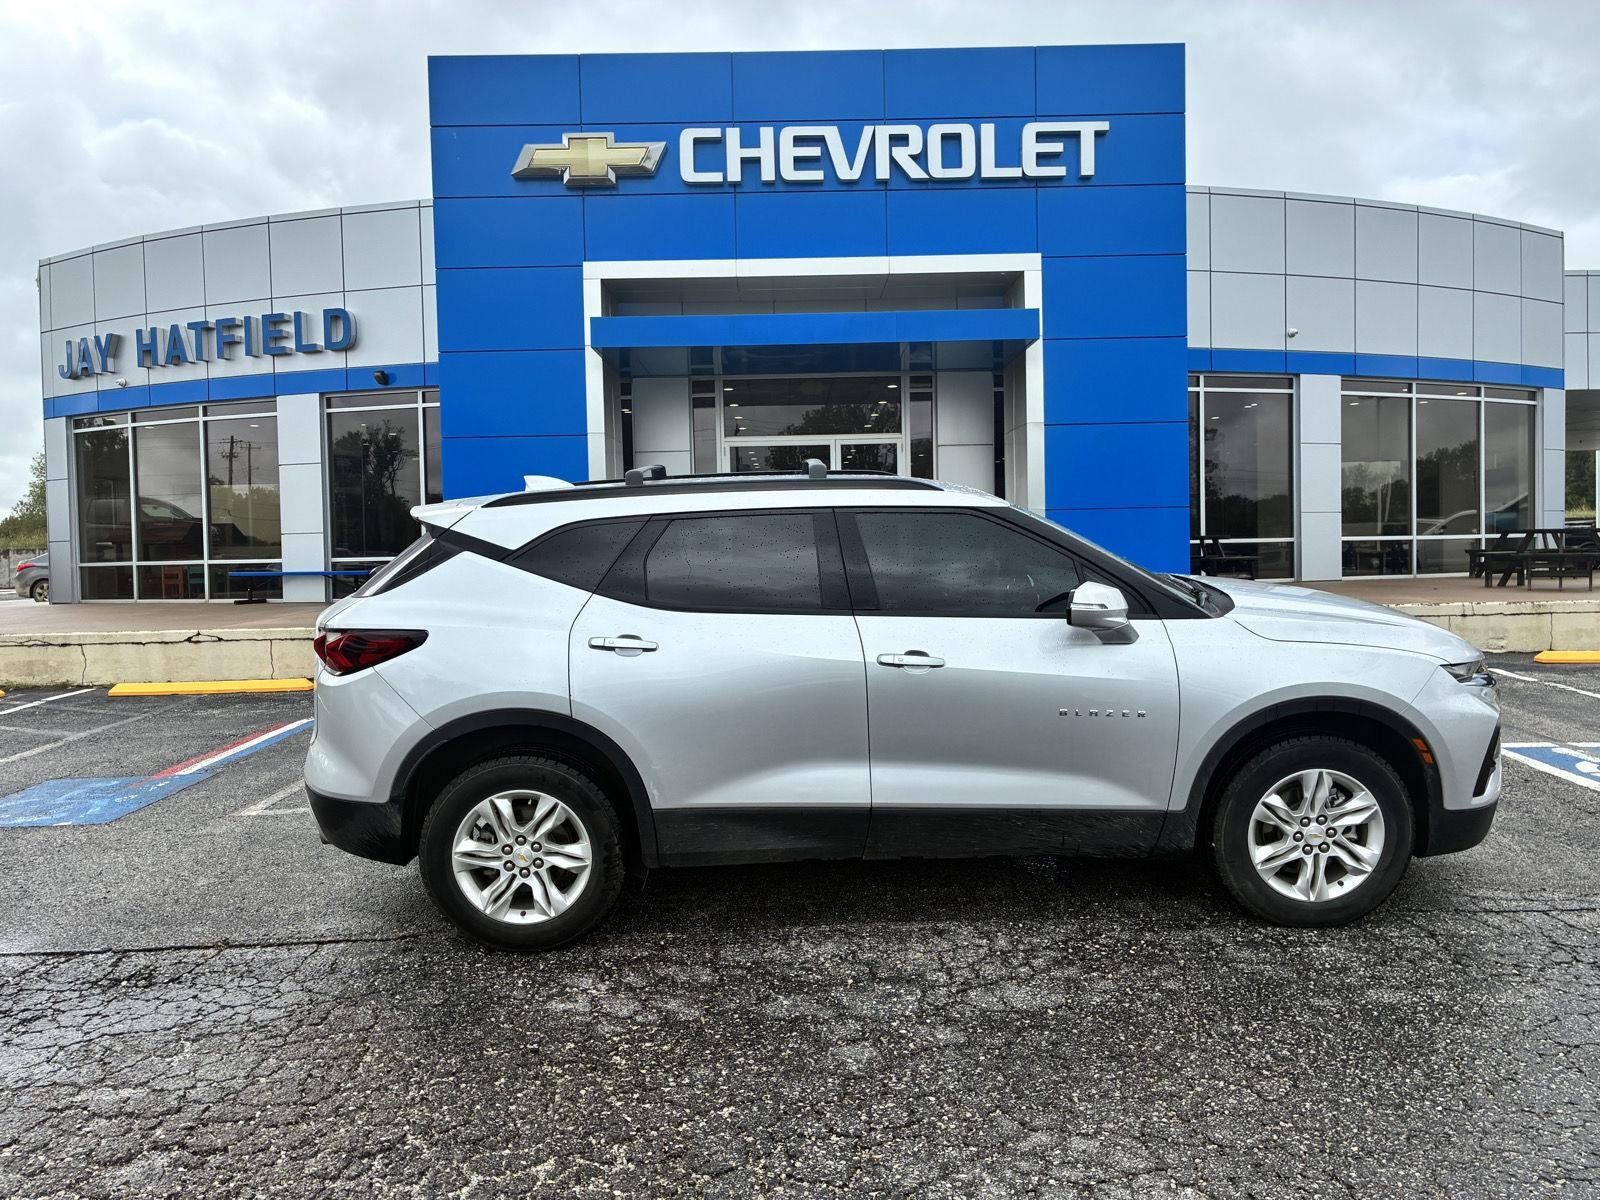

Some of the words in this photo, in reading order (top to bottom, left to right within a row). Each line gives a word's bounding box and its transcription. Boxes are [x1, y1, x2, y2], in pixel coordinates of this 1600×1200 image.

[678, 120, 1111, 186] CHEVROLET
[57, 332, 119, 380] JAY
[135, 307, 357, 368] HATFIELD
[1059, 708, 1148, 718] BLAZER
